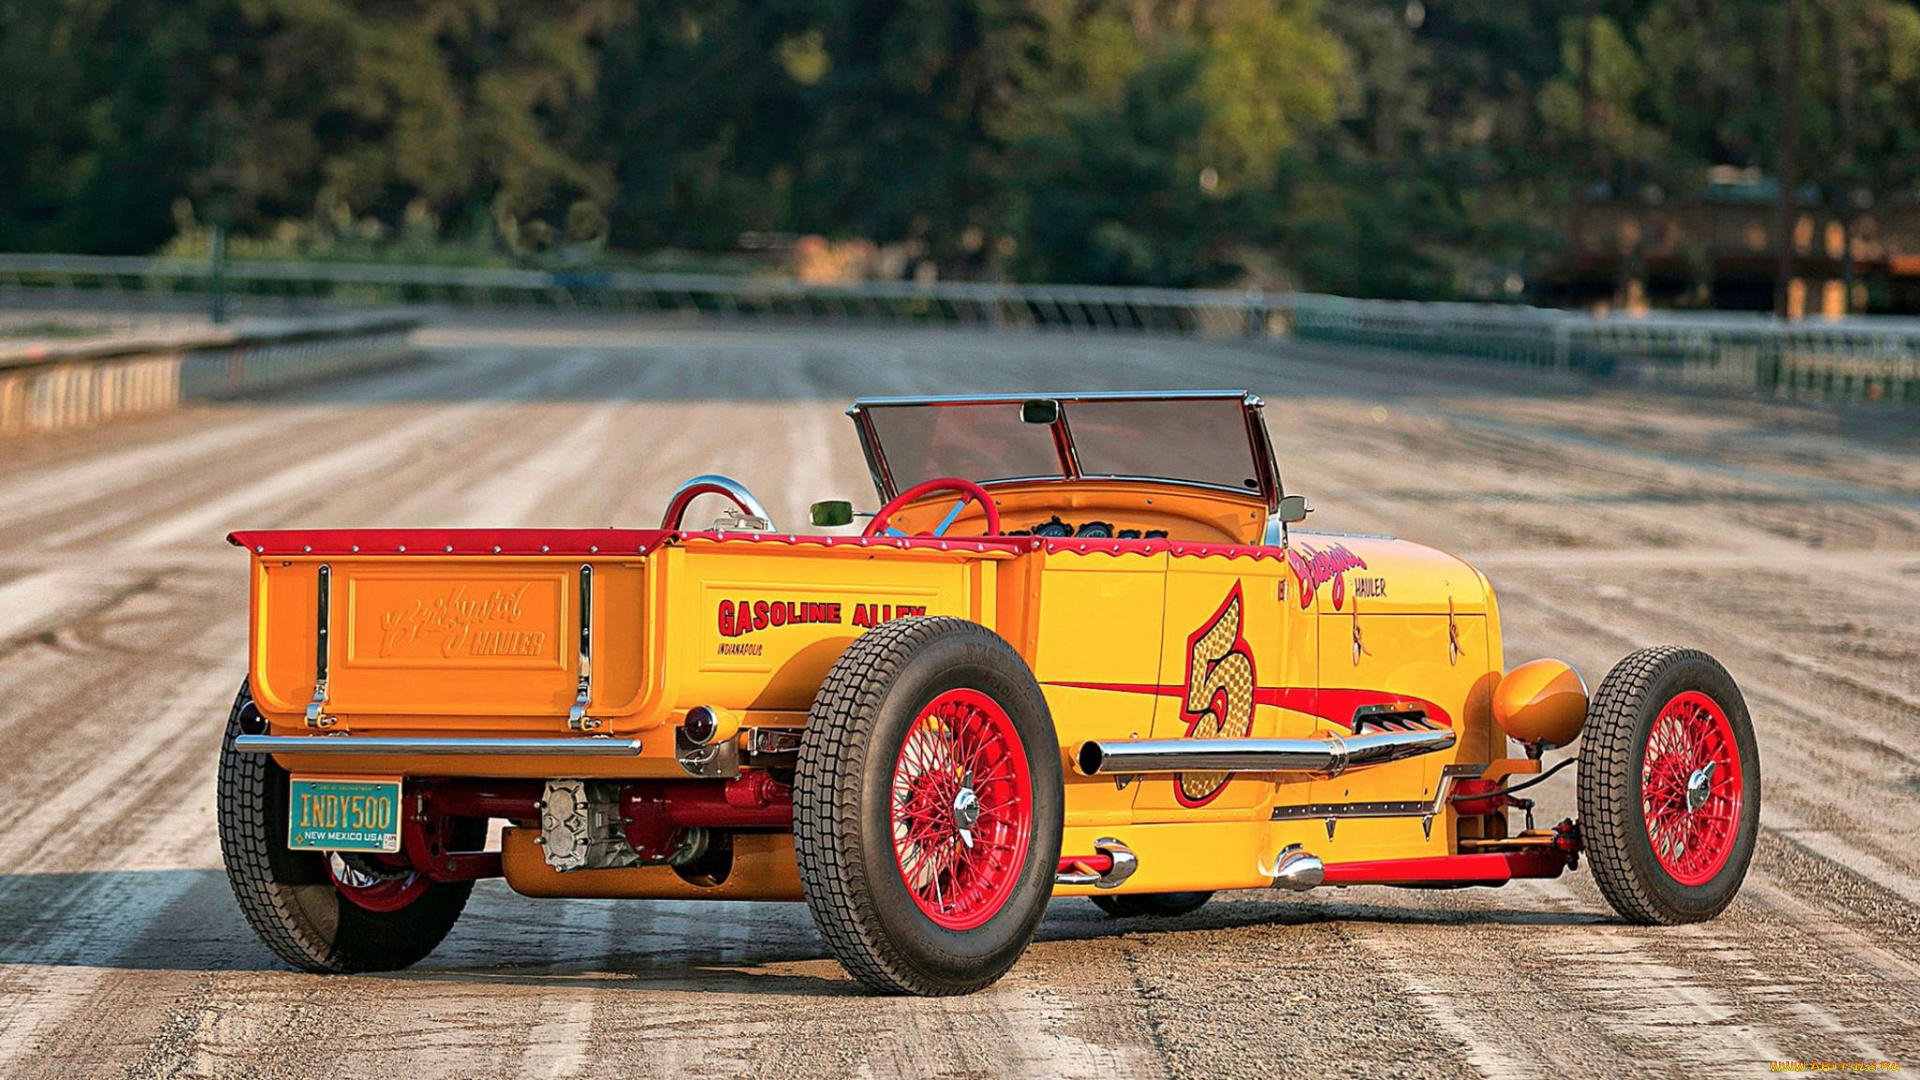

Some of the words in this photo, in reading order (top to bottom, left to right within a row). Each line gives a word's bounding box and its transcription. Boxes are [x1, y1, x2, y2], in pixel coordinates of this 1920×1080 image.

[1354, 577, 1387, 597] HAULER
[718, 599, 841, 637] GASOLINE
[469, 631, 545, 656] HAULER
[717, 643, 763, 656] INDIANAPOLIS
[1174, 577, 1257, 809] 5
[300, 793, 391, 830] INDY500
[304, 831, 326, 840] NEW
[328, 832, 362, 841] MEXICO
[364, 832, 383, 842] USA
